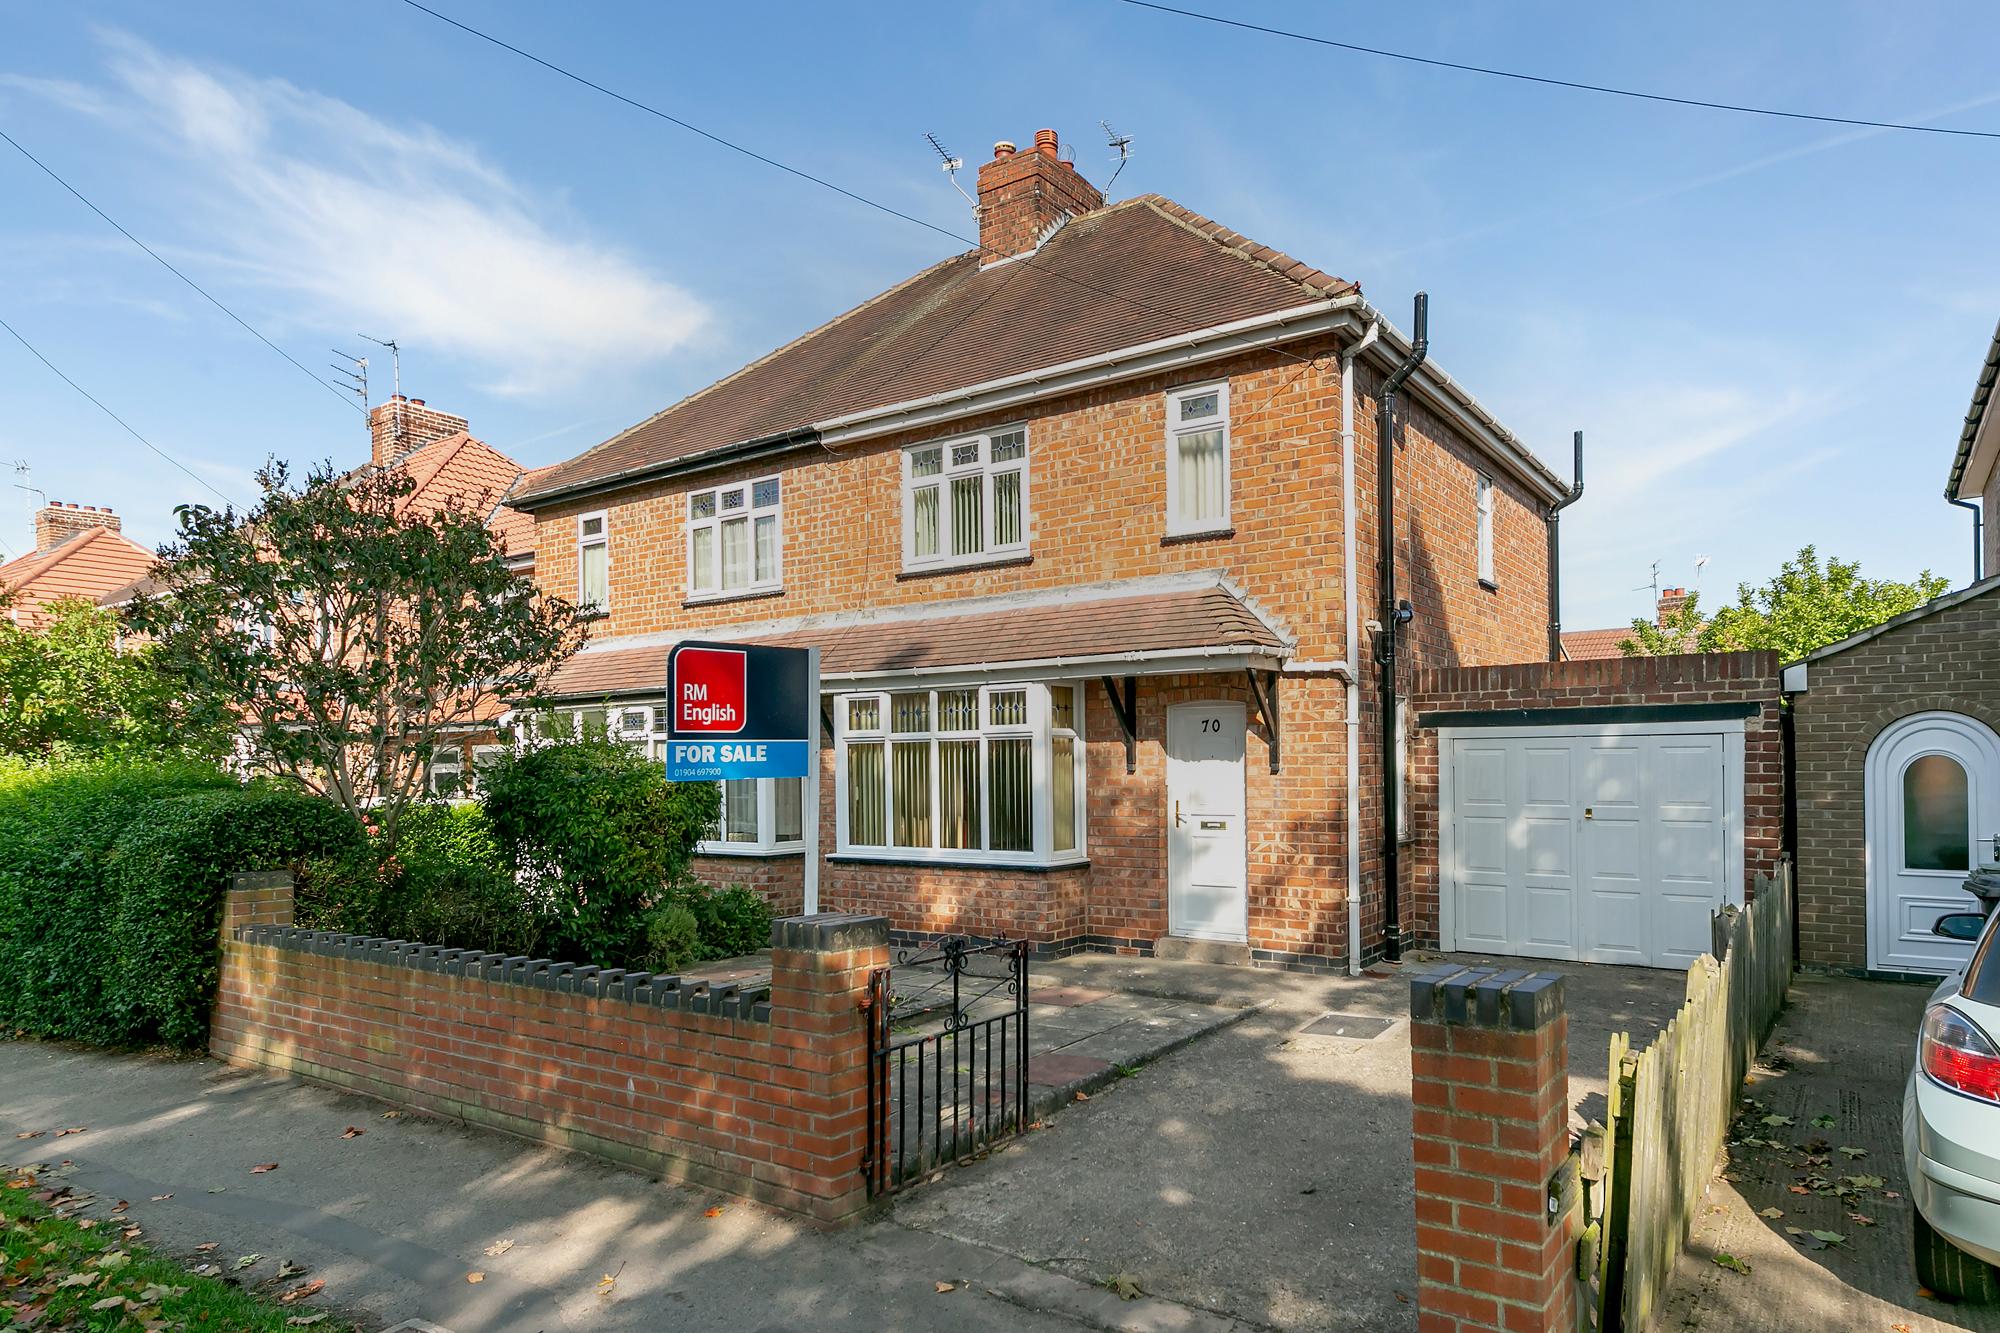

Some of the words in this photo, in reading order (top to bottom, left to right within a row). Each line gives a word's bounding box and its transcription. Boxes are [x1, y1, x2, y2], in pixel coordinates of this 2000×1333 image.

[683, 683, 708, 701] RM
[683, 703, 736, 725] English
[1201, 719, 1221, 733] 70
[675, 745, 715, 763] FOR
[720, 745, 768, 762] SALE
[674, 768, 696, 777] 01904
[697, 767, 722, 776] 697900
